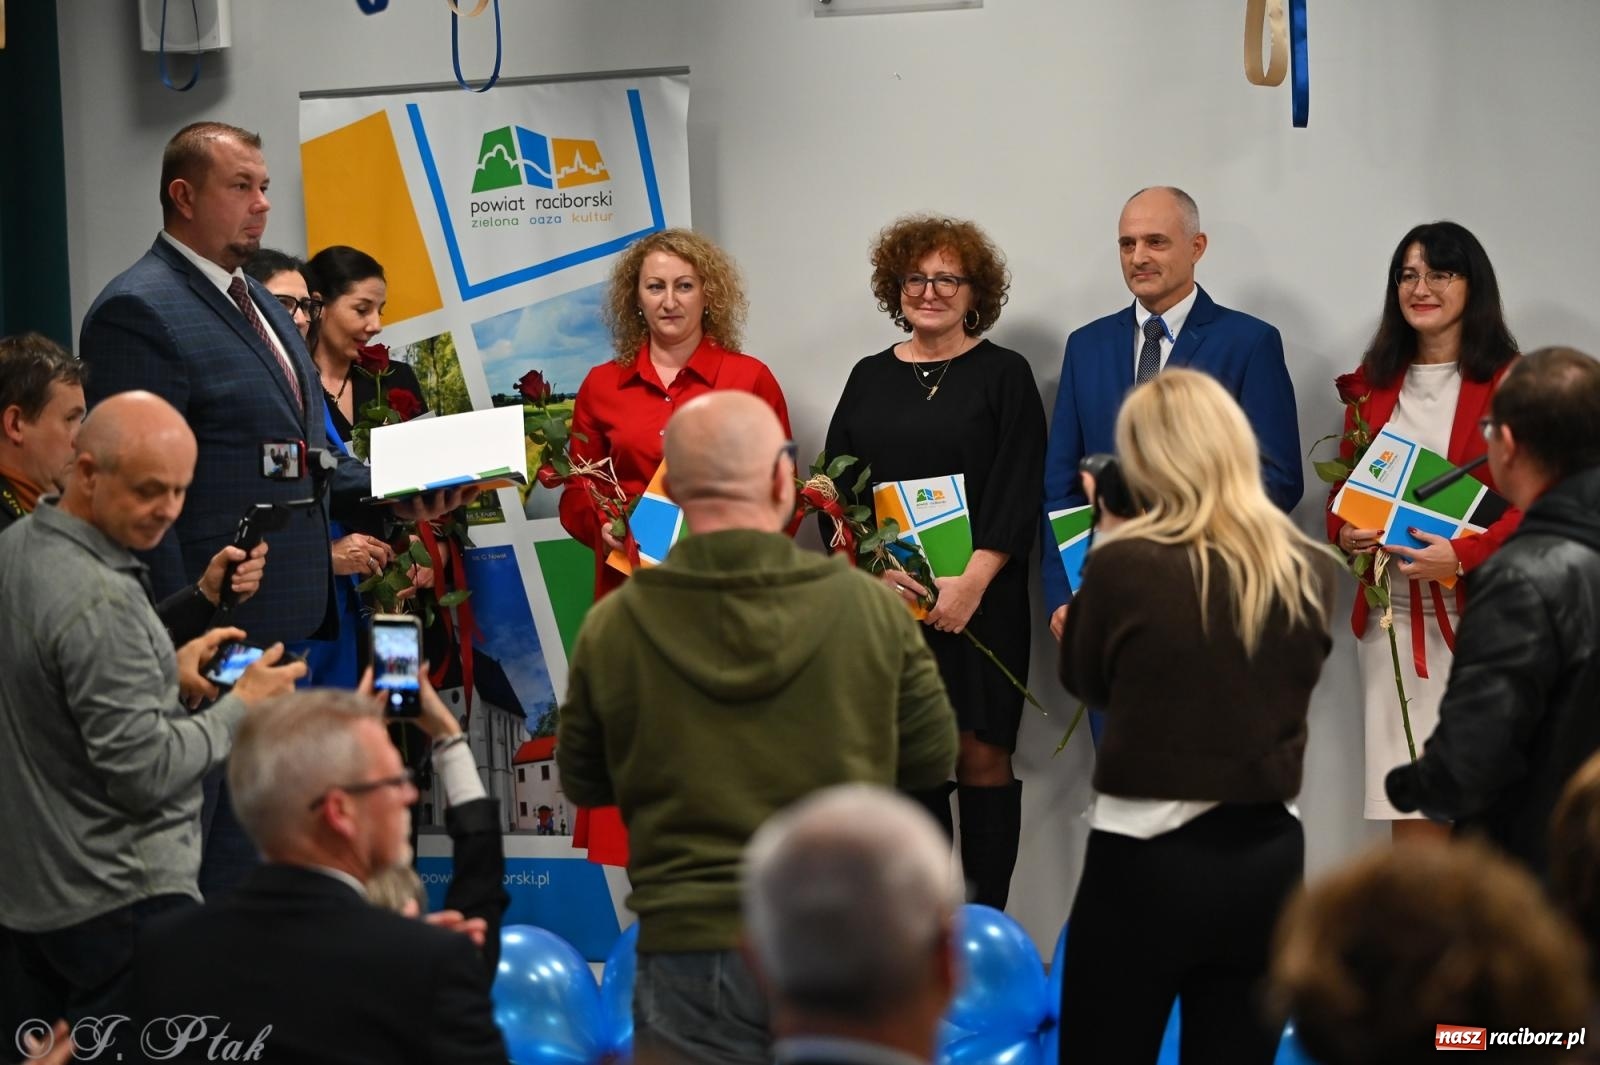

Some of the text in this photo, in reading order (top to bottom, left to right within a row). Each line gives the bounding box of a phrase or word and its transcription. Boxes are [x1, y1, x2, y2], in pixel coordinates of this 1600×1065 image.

[471, 190, 613, 217] powiat raciborski
[471, 211, 614, 228] zielona oaza kultur
